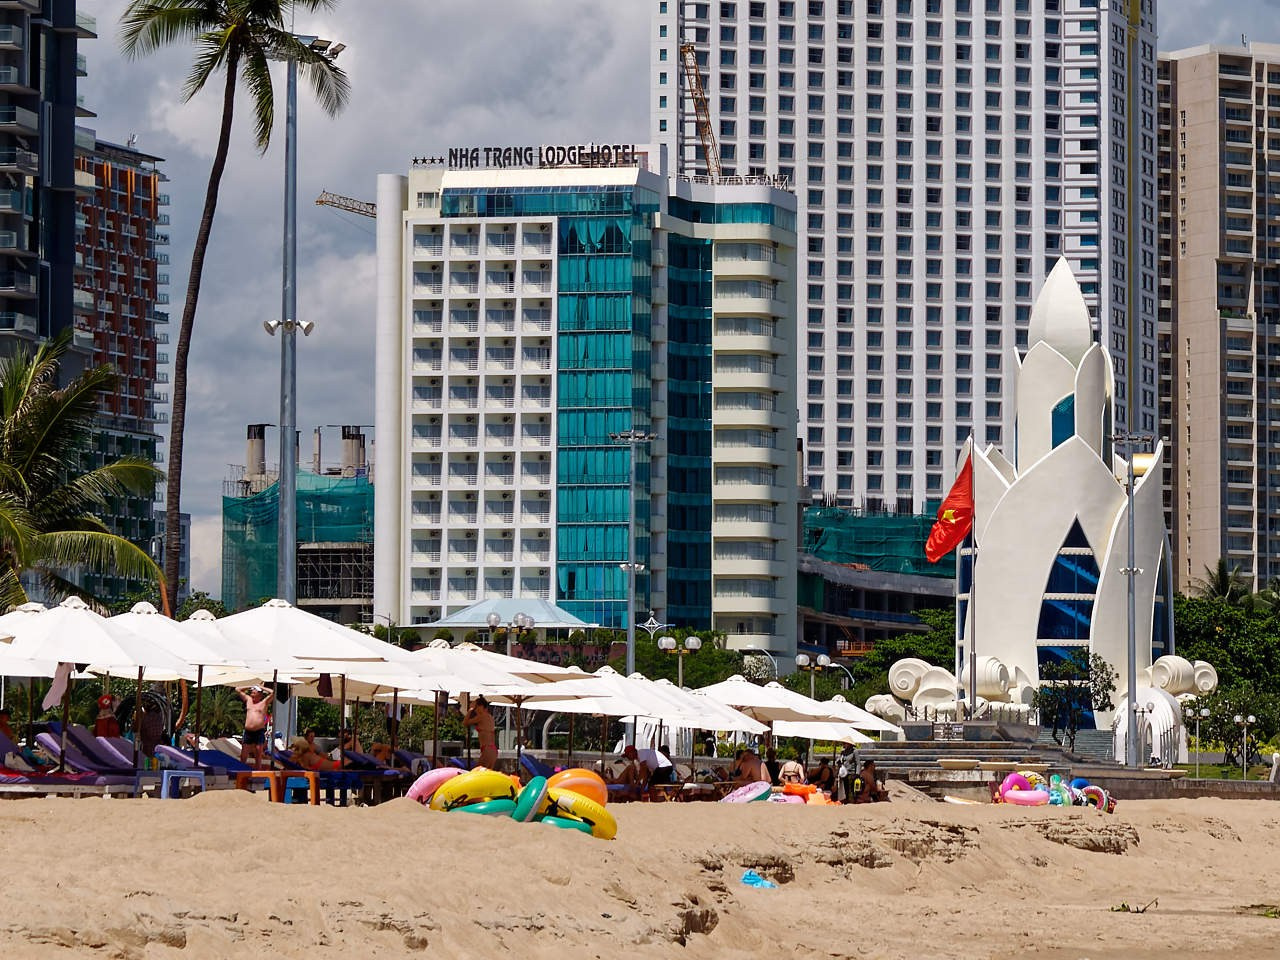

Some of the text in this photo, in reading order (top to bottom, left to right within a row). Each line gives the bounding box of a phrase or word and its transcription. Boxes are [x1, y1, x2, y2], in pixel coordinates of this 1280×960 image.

[449, 144, 638, 168] NHA TRANG LODGE HOTEL
